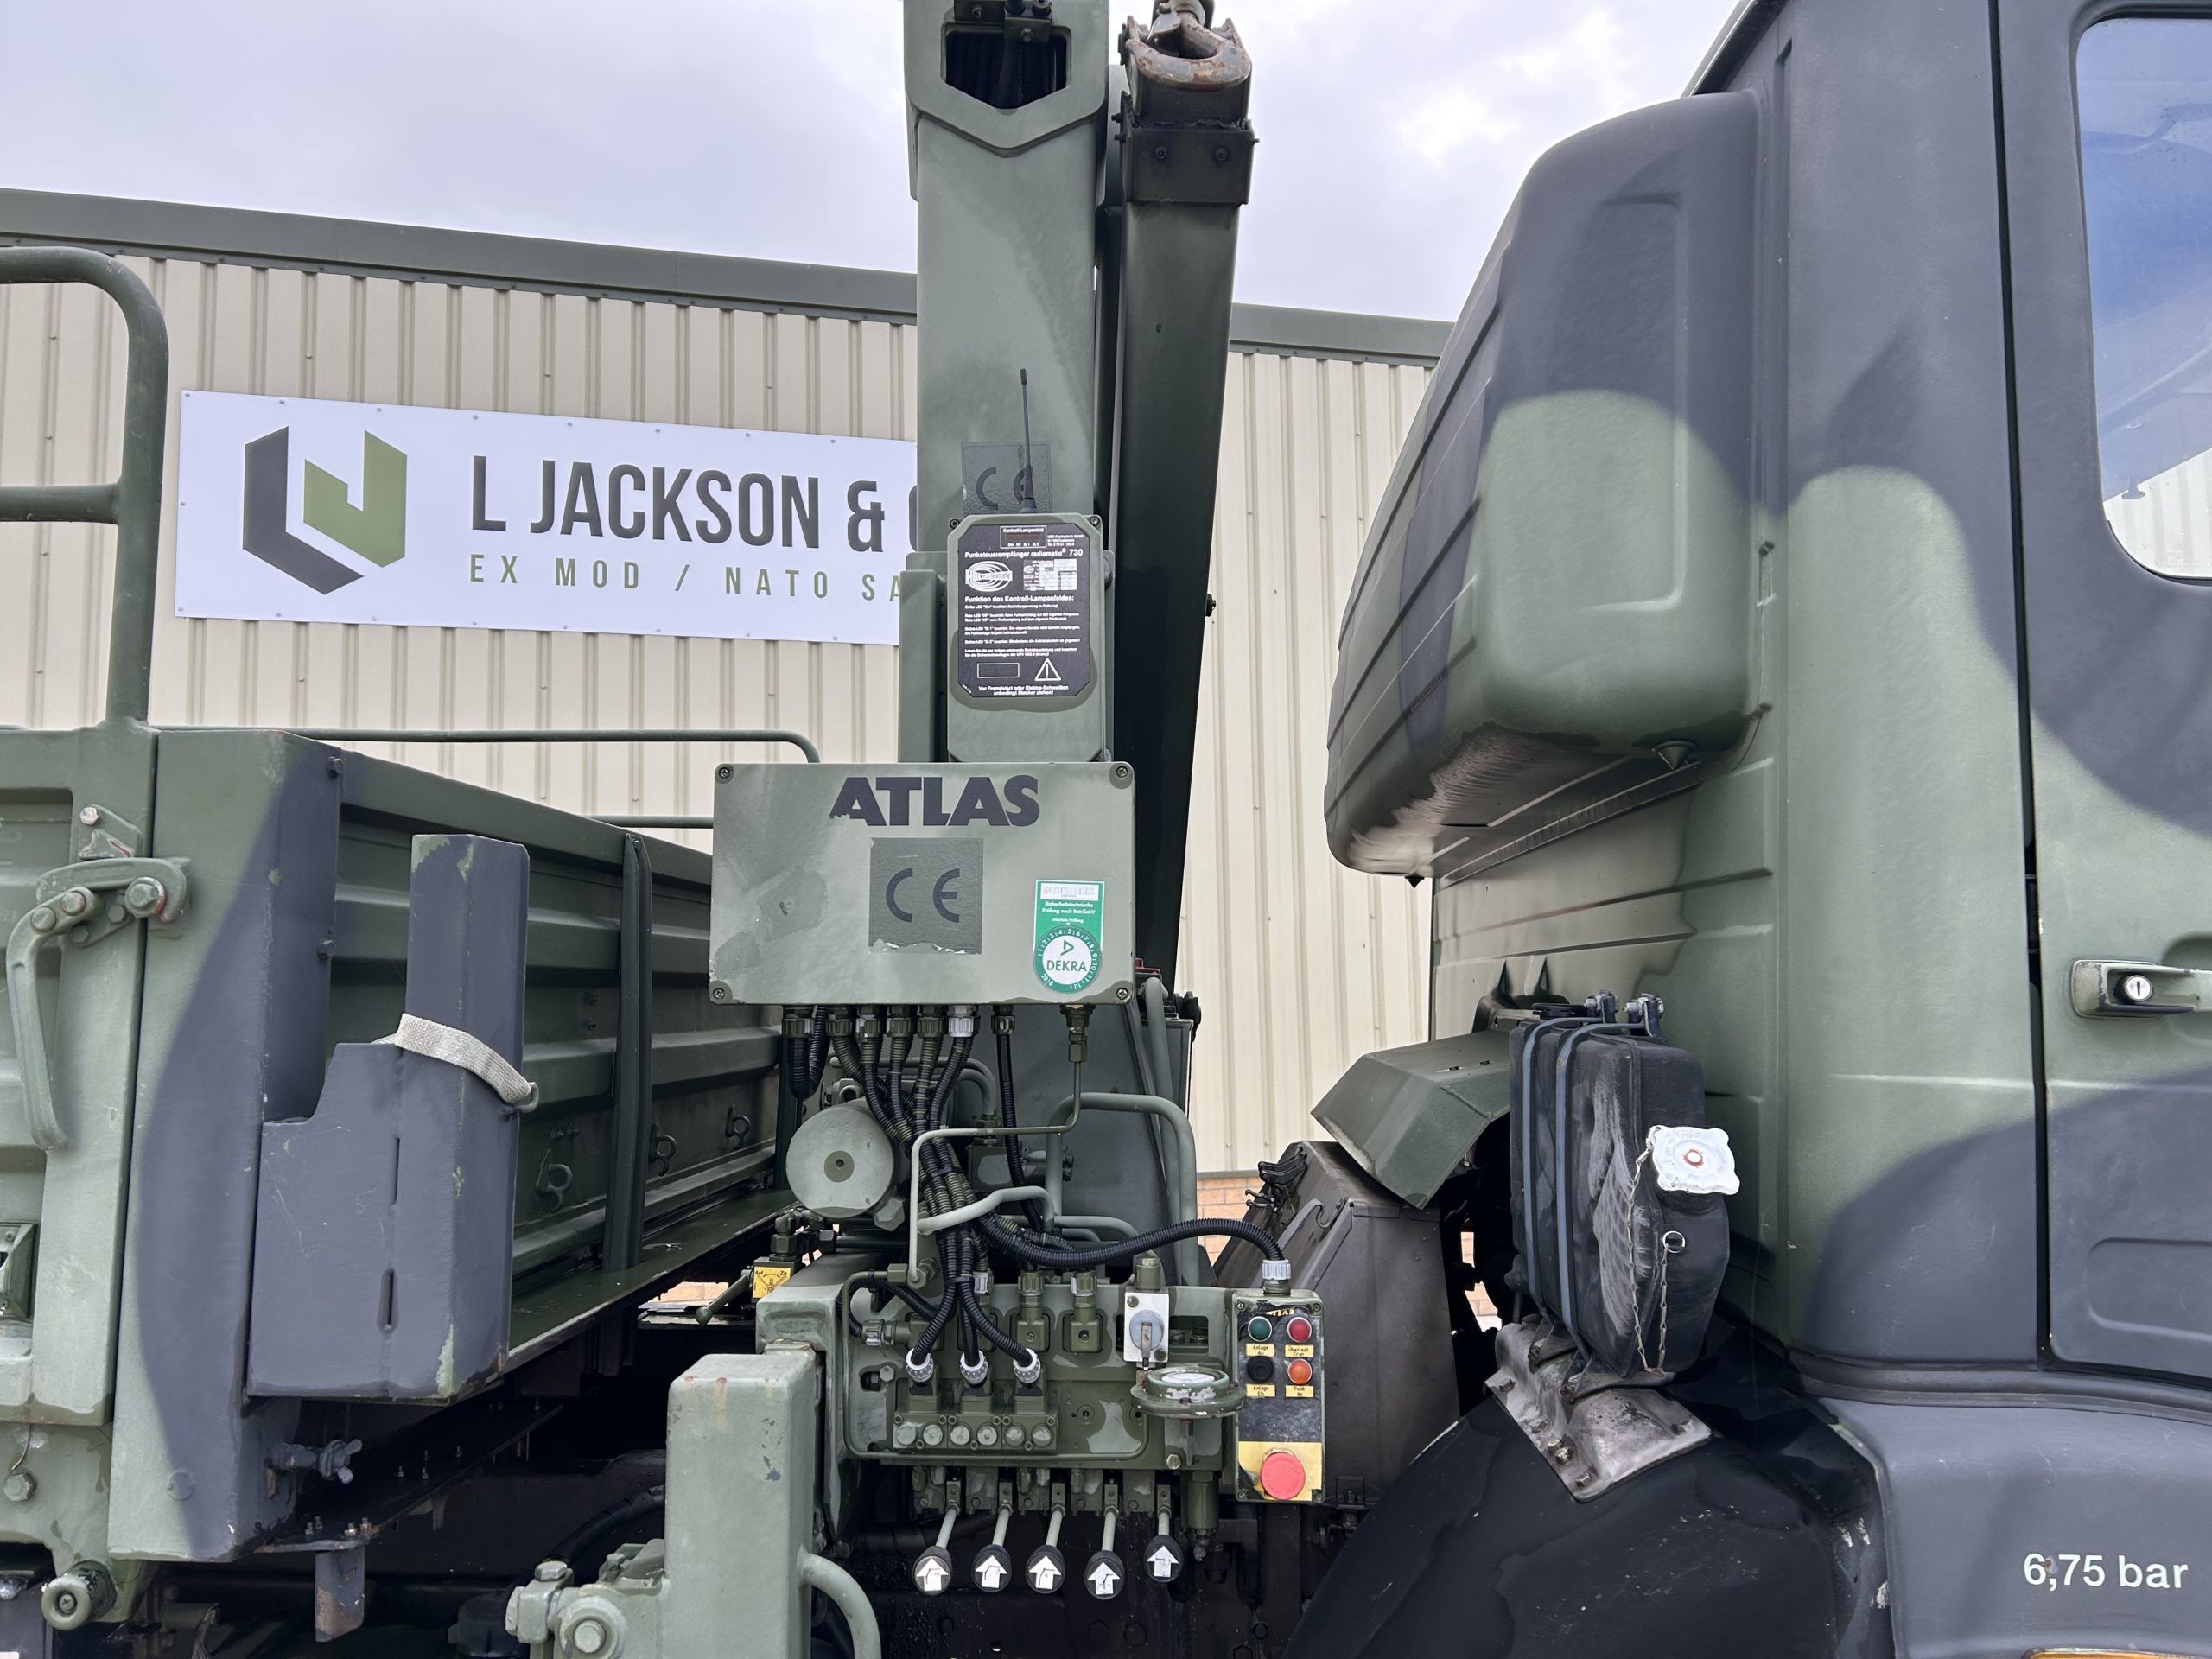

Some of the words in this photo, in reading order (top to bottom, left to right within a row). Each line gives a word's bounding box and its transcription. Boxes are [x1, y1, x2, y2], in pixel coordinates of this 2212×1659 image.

[473, 455, 506, 531] L
[530, 460, 819, 549] JACKSON
[847, 480, 885, 552] &
[470, 554, 518, 583] EX
[556, 558, 639, 589] MOD
[726, 567, 828, 599] NATO
[829, 774, 1040, 827] ATLAS
[885, 868, 960, 923] CE
[1046, 960, 1088, 972] DEKRA
[2024, 1553, 2106, 1592] 6,75
[2118, 1554, 2189, 1589] bar
